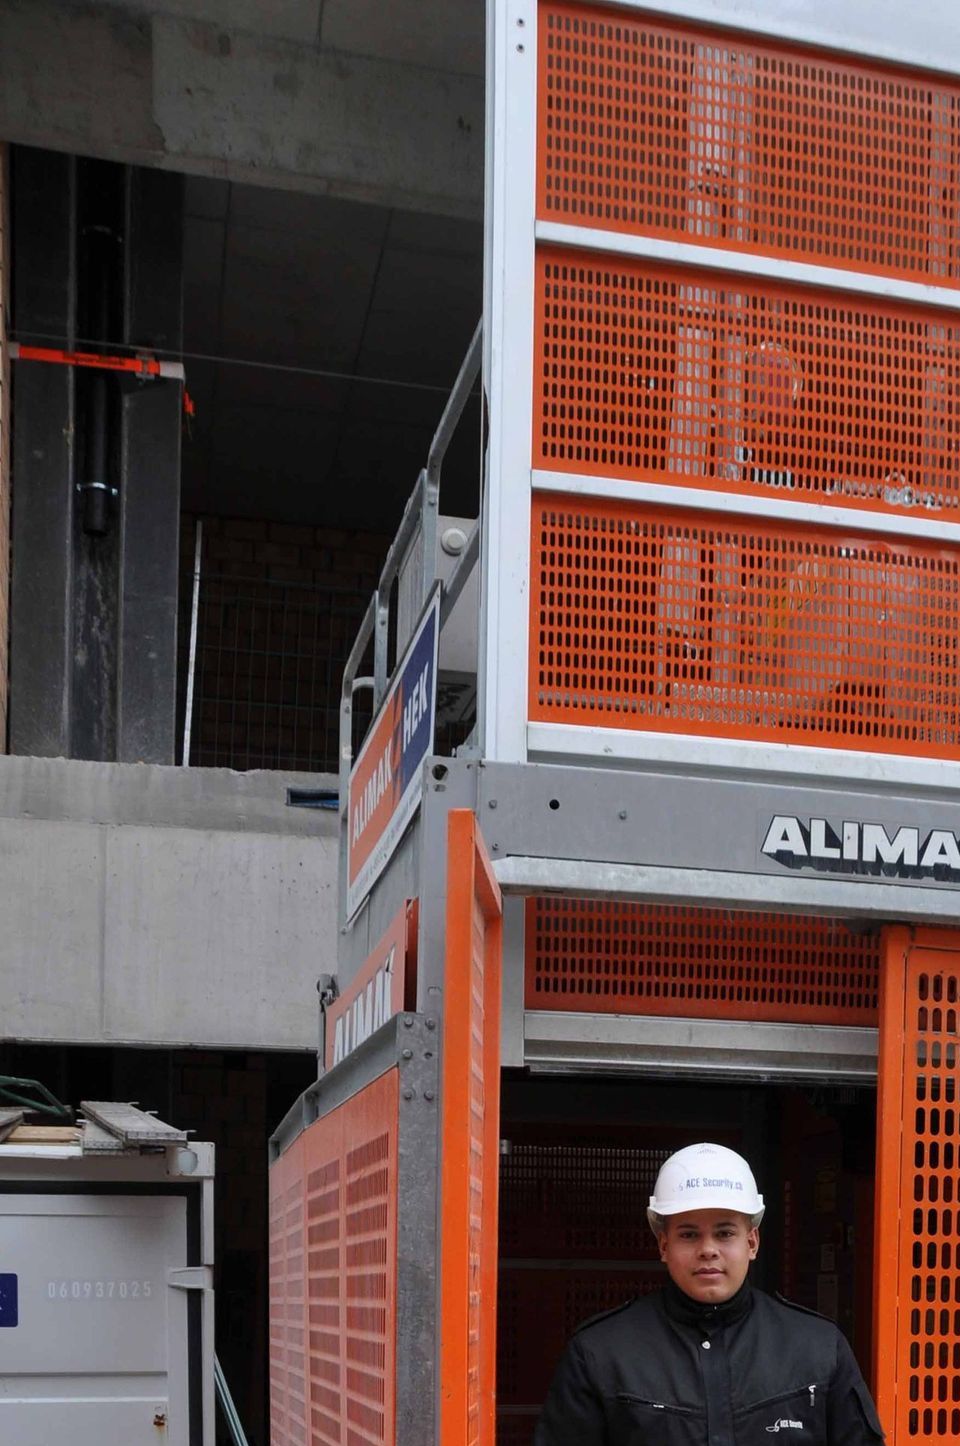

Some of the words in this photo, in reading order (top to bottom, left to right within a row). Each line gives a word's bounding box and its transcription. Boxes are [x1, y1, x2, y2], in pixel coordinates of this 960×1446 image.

[352, 738, 392, 848] ALIMAK
[402, 661, 428, 753] HEK
[47, 1281, 152, 1298] 060937025
